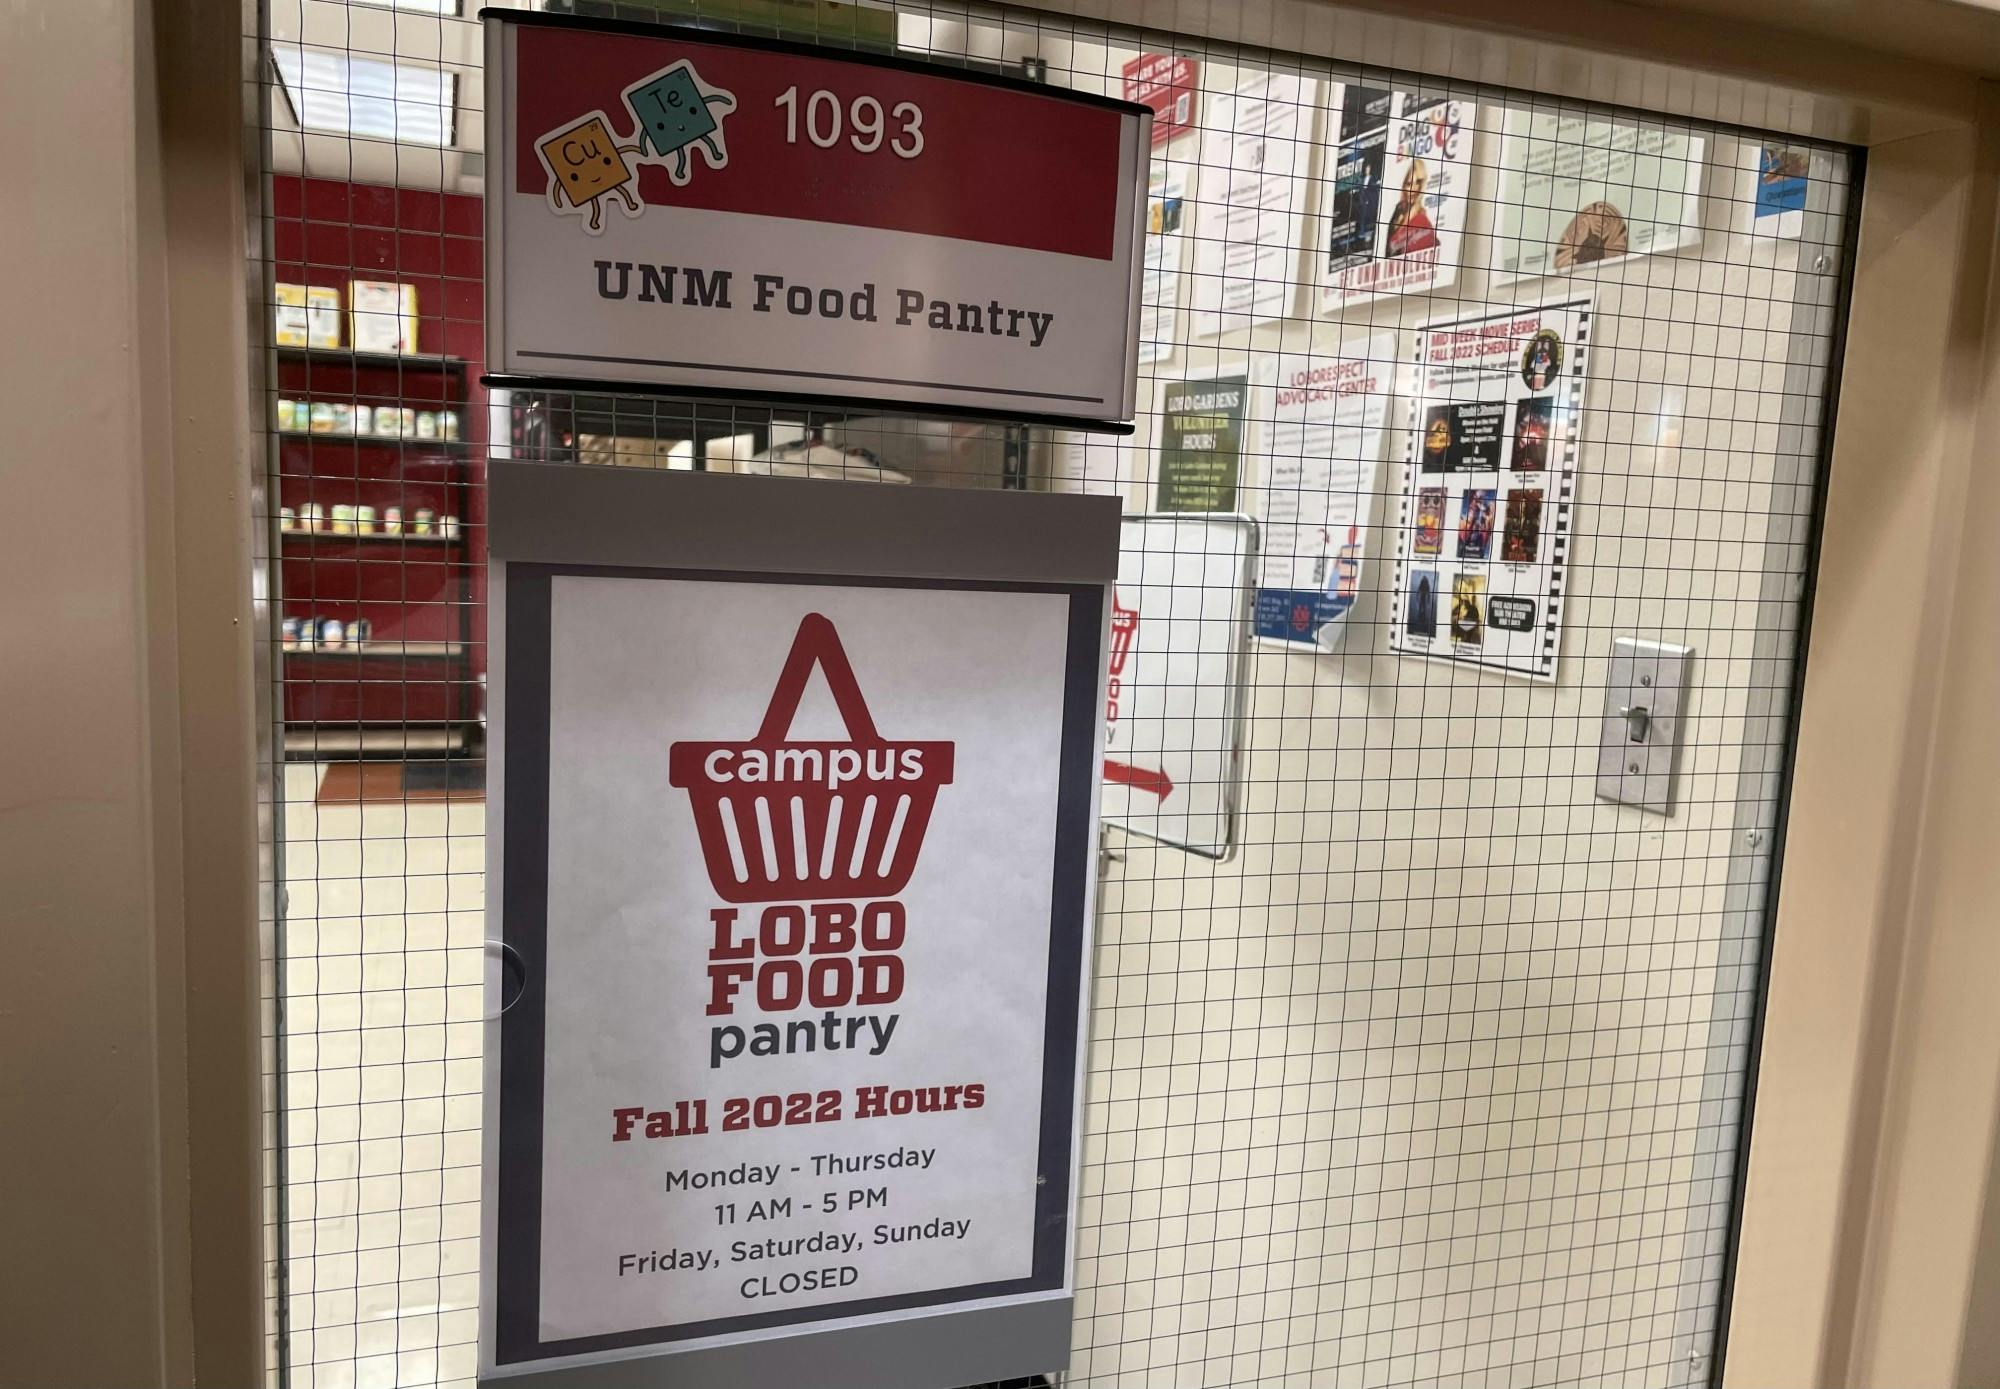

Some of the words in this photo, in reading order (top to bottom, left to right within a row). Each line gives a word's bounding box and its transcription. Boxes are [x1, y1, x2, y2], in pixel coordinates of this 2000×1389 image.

[648, 88, 683, 113] Te
[774, 86, 925, 159] 1093
[563, 139, 602, 166] Cu
[593, 260, 733, 309] UNM
[753, 274, 877, 322] Food
[895, 290, 1053, 348] Pantry
[1430, 349, 1447, 362] FALL
[1450, 345, 1473, 360] 2022
[1475, 340, 1520, 356] SCHEDULE
[1277, 385, 1335, 406] ADVOCACY
[1338, 377, 1377, 398] CENTER
[1290, 361, 1364, 387] LOBORESPECT
[704, 748, 924, 790] campus
[709, 900, 906, 960] LOBO
[705, 954, 905, 1016] FOOD
[710, 1011, 900, 1069] pantry
[612, 1099, 709, 1142] Fall
[722, 1090, 842, 1132] 2022
[854, 1083, 985, 1119] Hours
[665, 1162, 781, 1192] Monday
[810, 1147, 936, 1176] Thursday
[715, 1203, 735, 1225] 11
[746, 1197, 792, 1223] AM
[823, 1192, 838, 1213] 5
[848, 1187, 889, 1211] PM
[618, 1248, 720, 1277] Friday,
[731, 1231, 863, 1263] Saturday,
[873, 1217, 971, 1246] Sunday
[740, 1265, 858, 1300] CLOSED
